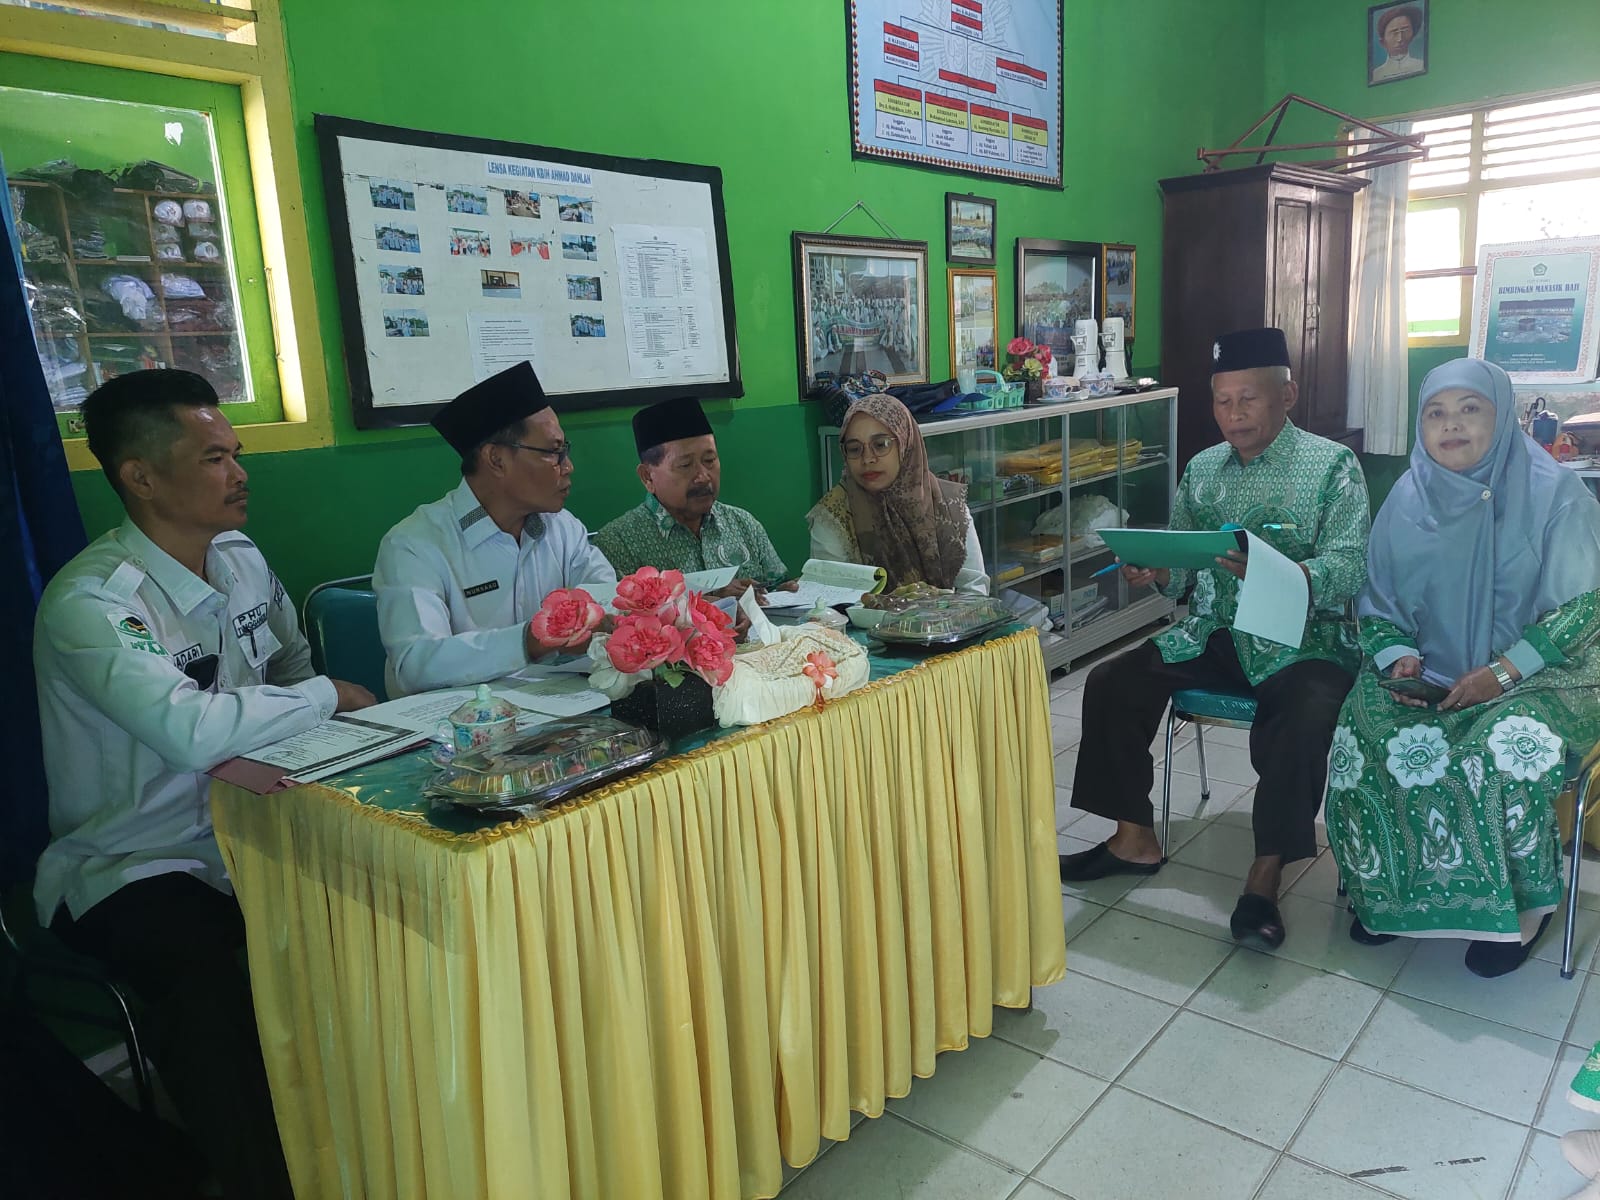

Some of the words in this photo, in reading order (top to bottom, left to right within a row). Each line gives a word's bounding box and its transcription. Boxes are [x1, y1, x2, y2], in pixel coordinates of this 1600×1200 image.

[488, 161, 507, 175] LENSA
[507, 163, 536, 178] KEGIATAN
[536, 167, 550, 180] KBIH
[551, 169, 570, 182] AHMAD
[570, 171, 592, 185] DAHLAN
[1535, 283, 1563, 293] MANASIK
[1565, 282, 1580, 291] HAJI
[238, 607, 262, 625] PHU
[173, 645, 201, 671] ADARI
